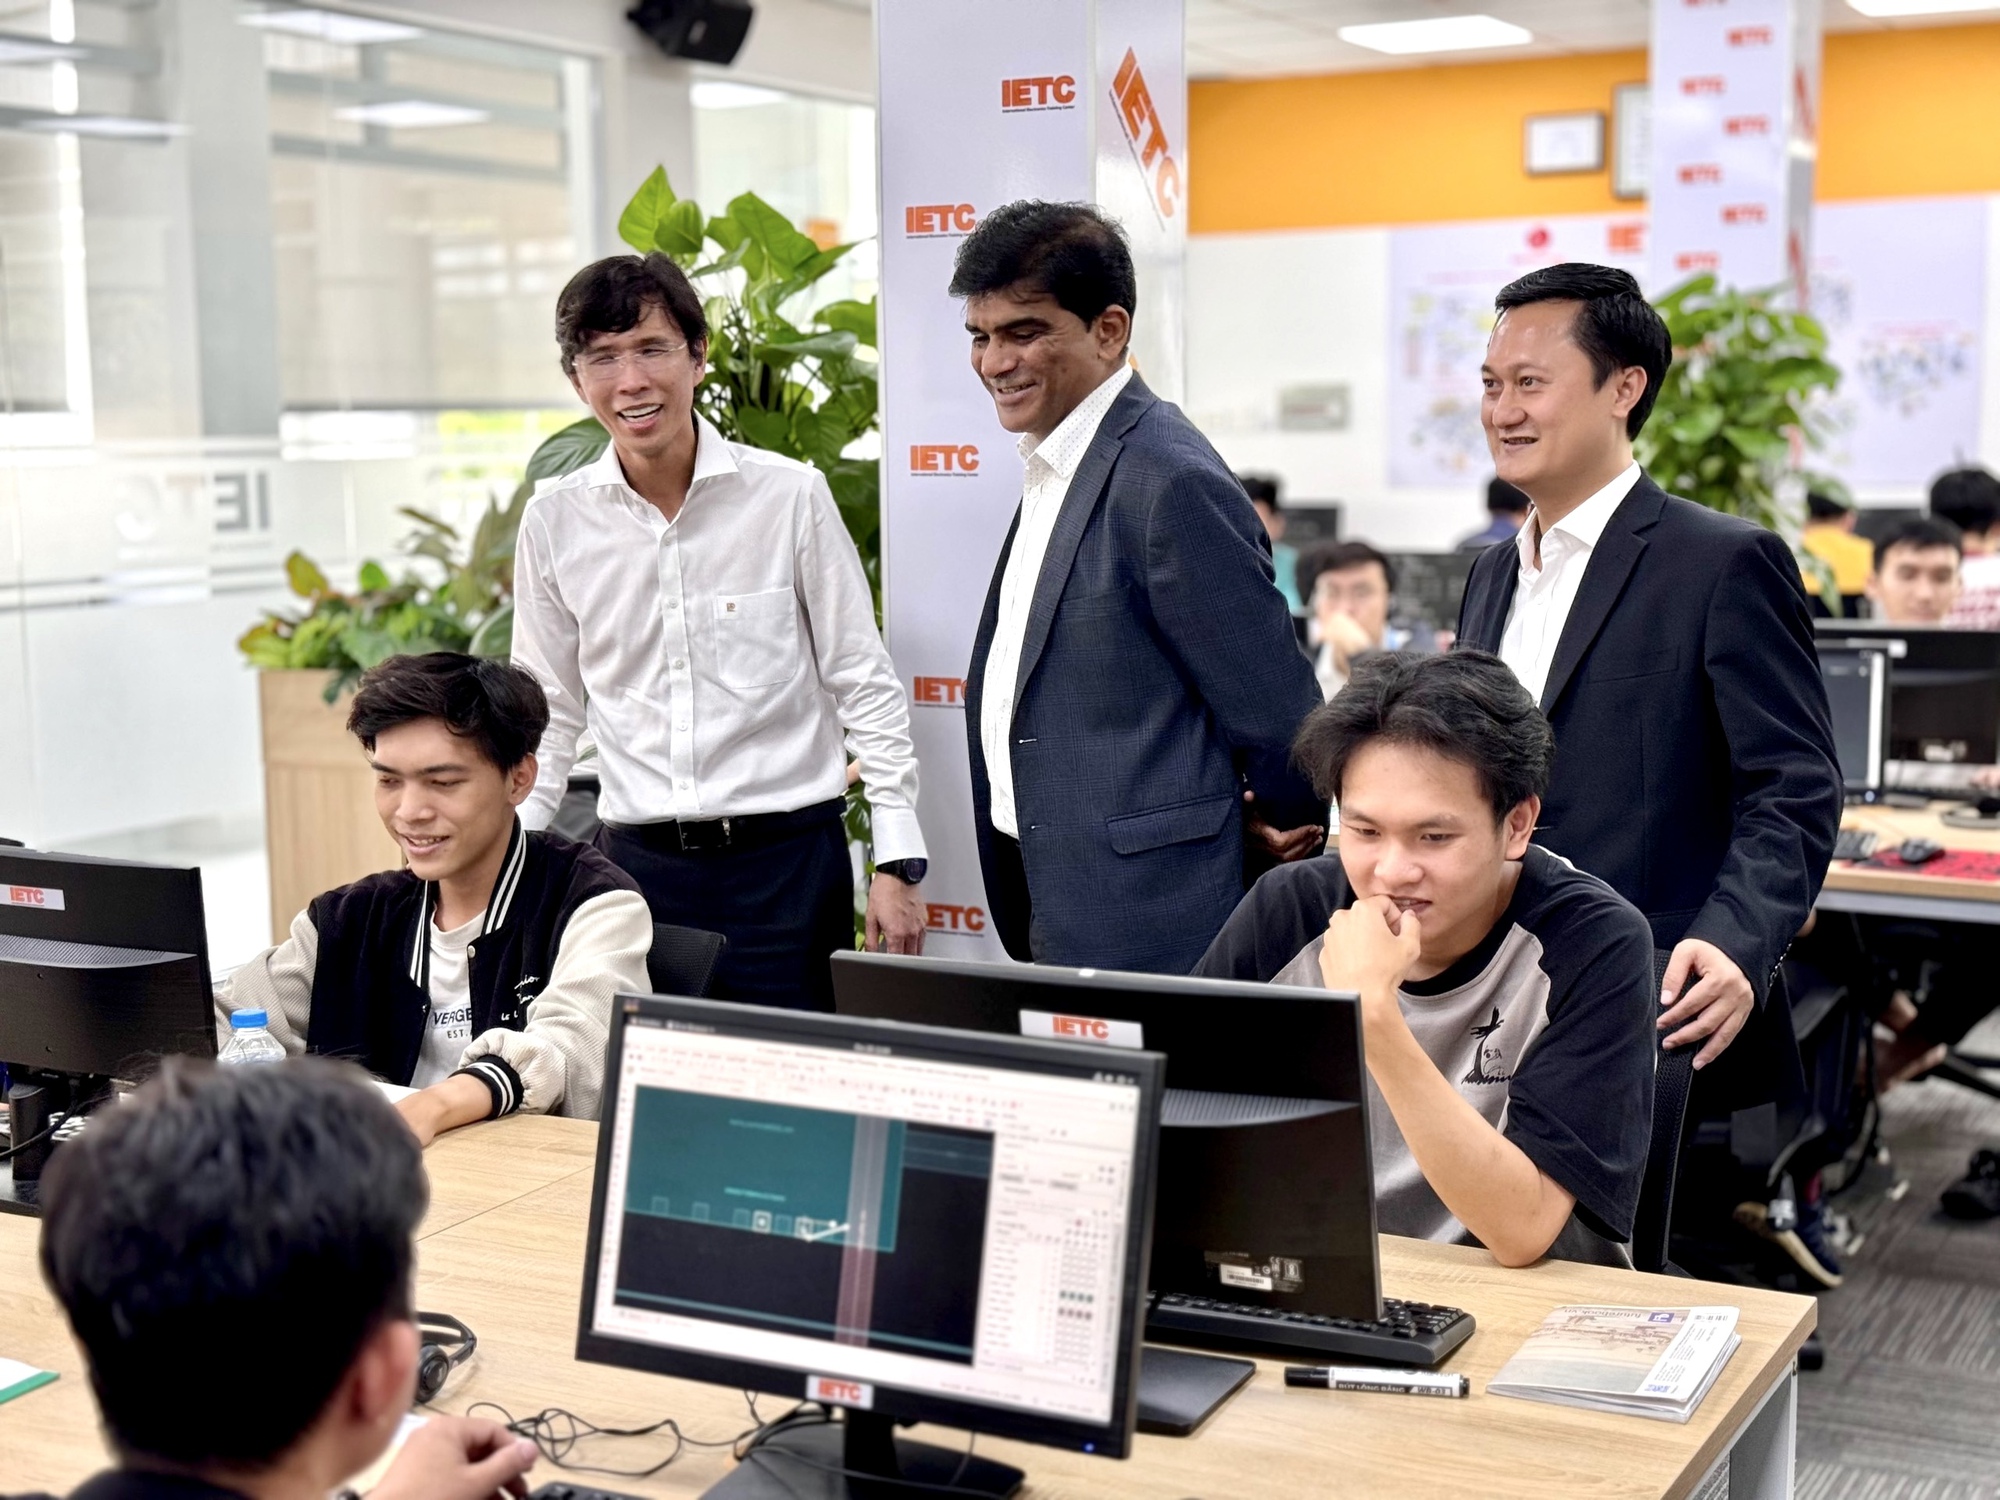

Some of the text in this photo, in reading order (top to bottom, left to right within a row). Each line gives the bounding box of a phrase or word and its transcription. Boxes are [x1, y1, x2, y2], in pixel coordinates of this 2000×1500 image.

[1001, 75, 1076, 108] IETC
[1112, 46, 1180, 218] IETC
[906, 203, 976, 233] IETC
[910, 444, 979, 471] IETC
[10, 886, 45, 904] IETC
[926, 903, 985, 931] ETC
[1052, 1015, 1109, 1039] IETC
[818, 1379, 862, 1400] IETC
